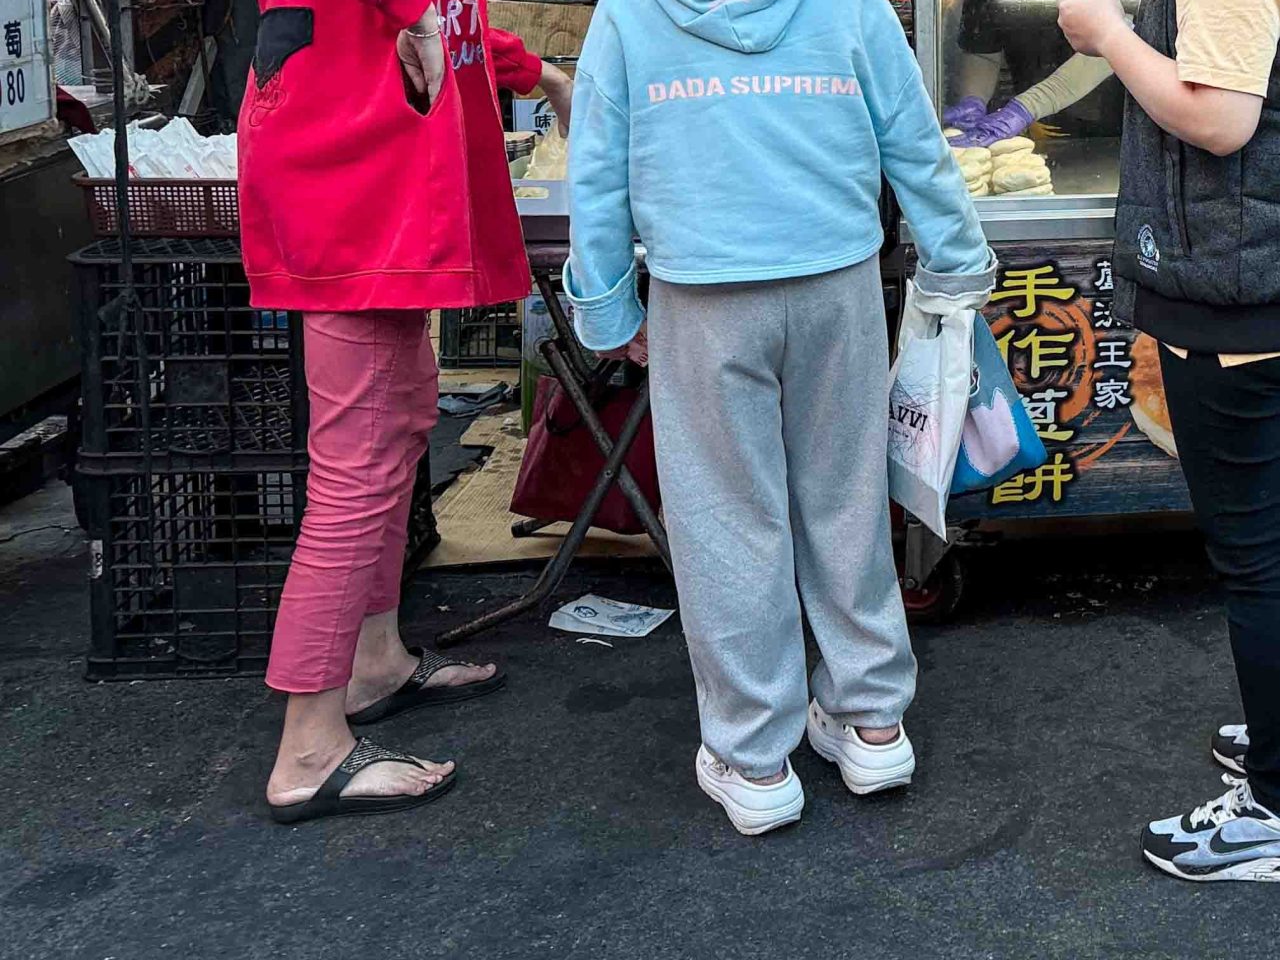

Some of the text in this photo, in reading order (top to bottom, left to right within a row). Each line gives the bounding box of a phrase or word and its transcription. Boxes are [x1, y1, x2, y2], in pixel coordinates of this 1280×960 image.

[7, 68, 25, 106] 80
[648, 74, 864, 103] DADA SUPREM
